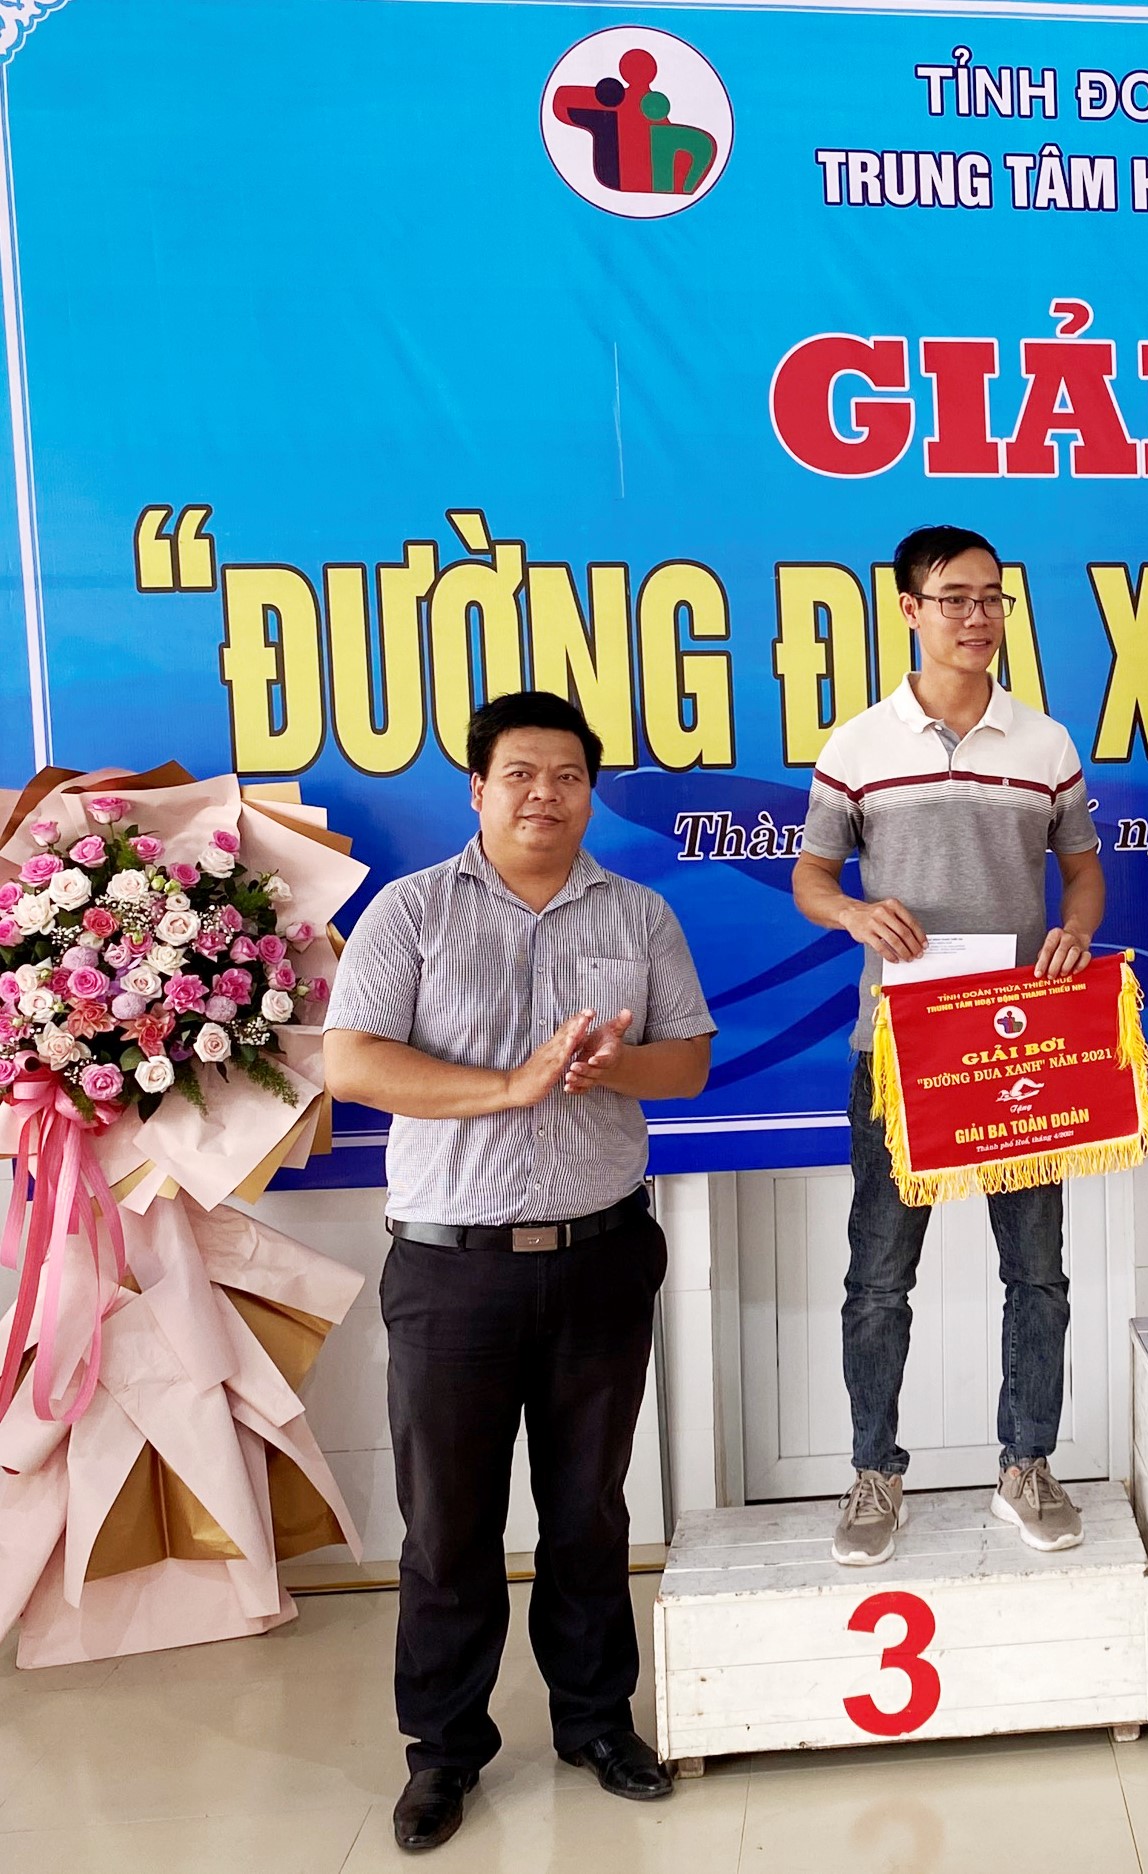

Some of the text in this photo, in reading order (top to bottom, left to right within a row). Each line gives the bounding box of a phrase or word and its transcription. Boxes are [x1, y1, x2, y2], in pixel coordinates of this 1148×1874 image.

[915, 45, 1055, 118] TỈNH
[816, 149, 992, 209] TRUNG
[1004, 143, 1118, 213] TÂM
[674, 811, 805, 860] Thàn
[926, 1004, 954, 1013] TRUNG
[955, 1000, 973, 1009] TÂM
[974, 997, 995, 1006] HOẠT
[997, 993, 1019, 1004] ĐỘNG
[1021, 990, 1046, 999] THANH
[1049, 985, 1070, 995] THIẾU
[937, 975, 1073, 1002] TỈNH ĐOÀN THỪA THIÊN HUẾ
[917, 1048, 1112, 1089] "ĐƯỜNG ĐUA XANH" NĂM 2021
[961, 1037, 1066, 1066] GIẢI BƠI
[955, 1106, 1090, 1144] GIẢI BA TOÀN ĐOÀN
[844, 1592, 940, 1736] 3
